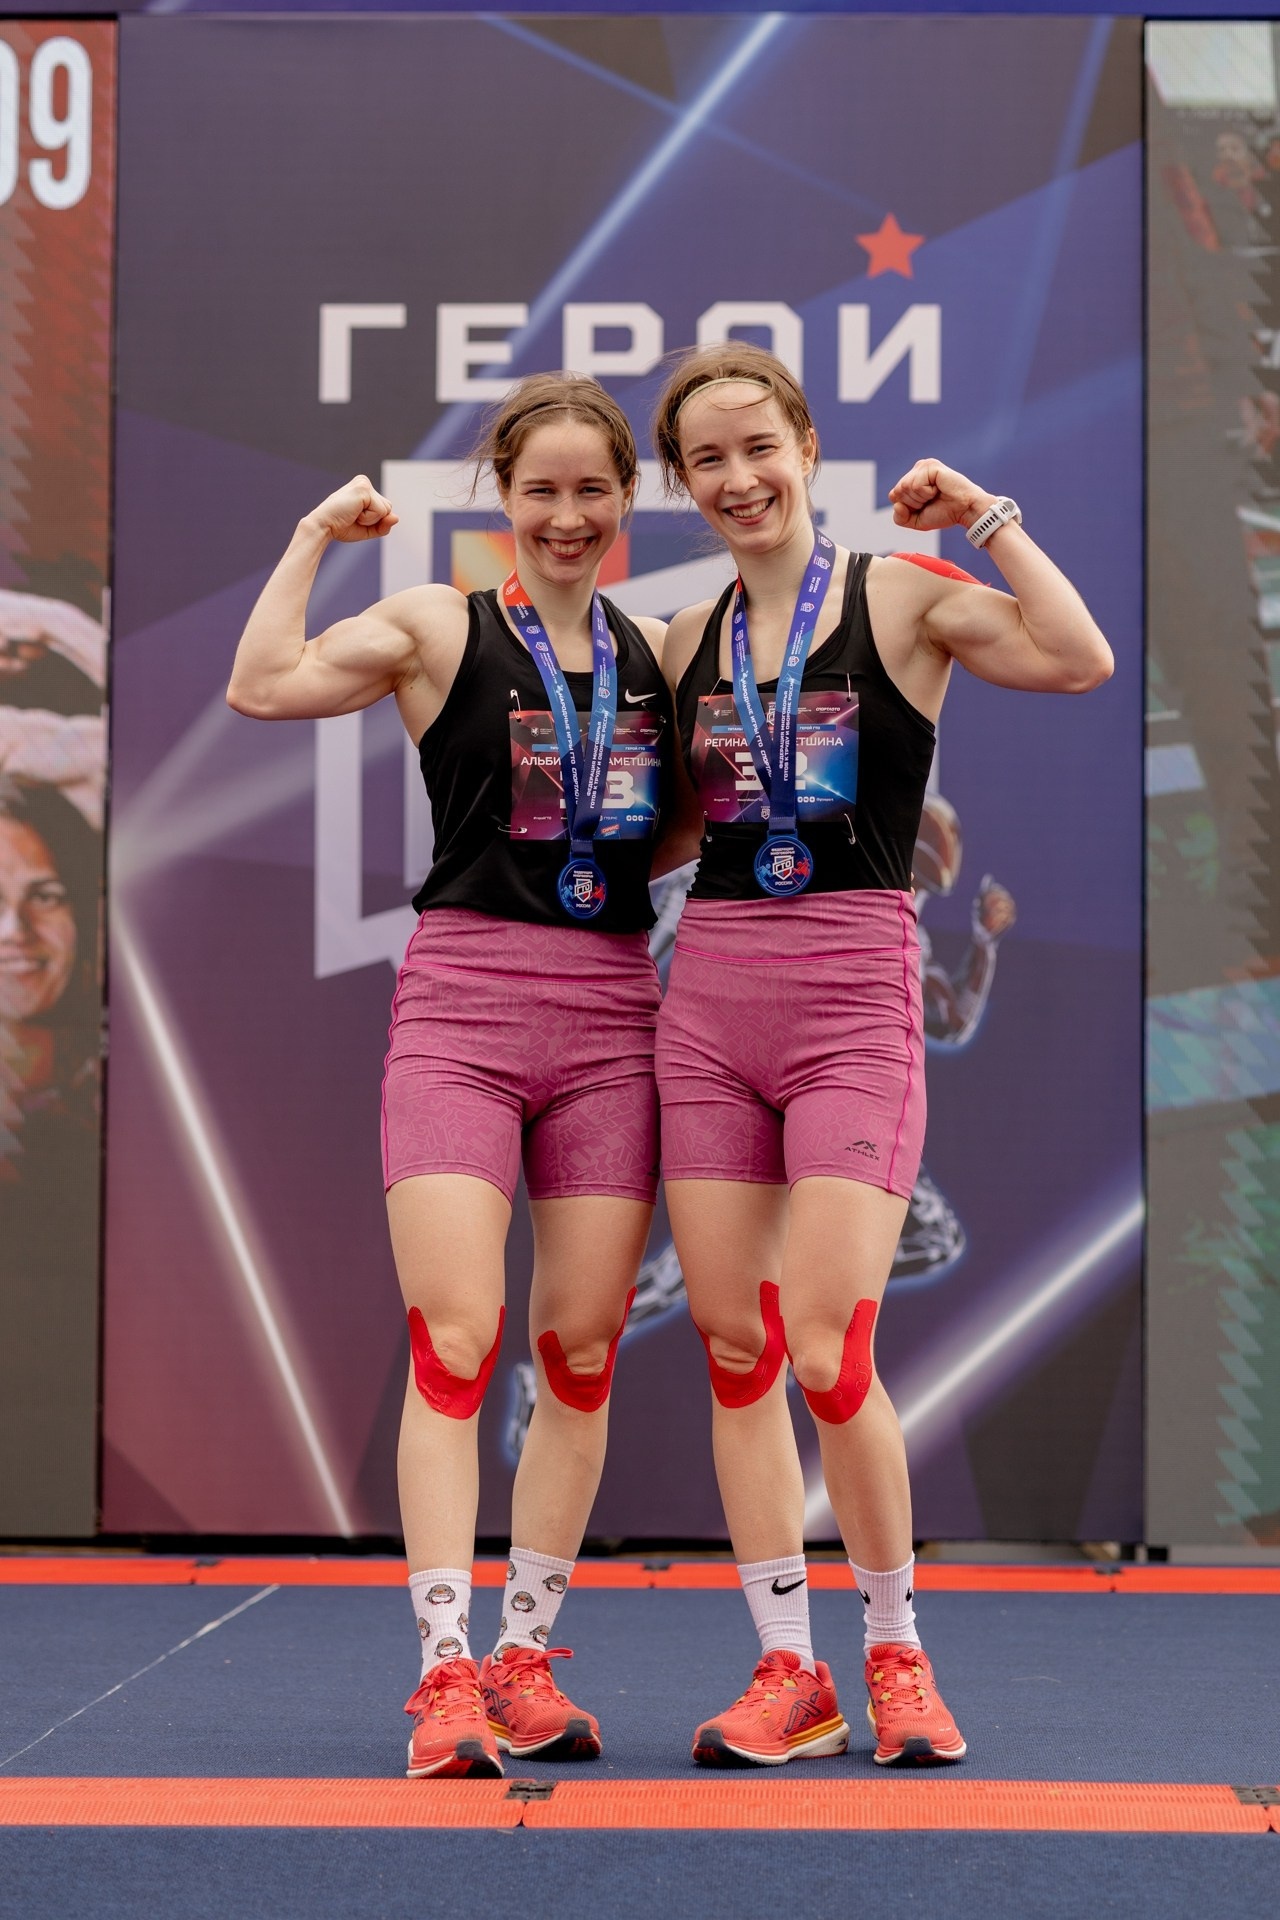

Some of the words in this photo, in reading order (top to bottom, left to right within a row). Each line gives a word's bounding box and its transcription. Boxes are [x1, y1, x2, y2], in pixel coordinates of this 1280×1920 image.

[750, 715, 759, 734] ИГРЫ
[704, 738, 748, 747] РЕГИНА
[521, 757, 561, 766] АЛЬБИ
[609, 757, 661, 767] АМЕТШИНА
[587, 760, 595, 796] ФЕДЕРАЦИЯ
[593, 721, 601, 759] МНОГОБОРЬЯ
[776, 860, 791, 872] ГТО
[576, 881, 590, 894] ГТО
[844, 1146, 880, 1161] ATHLEX
